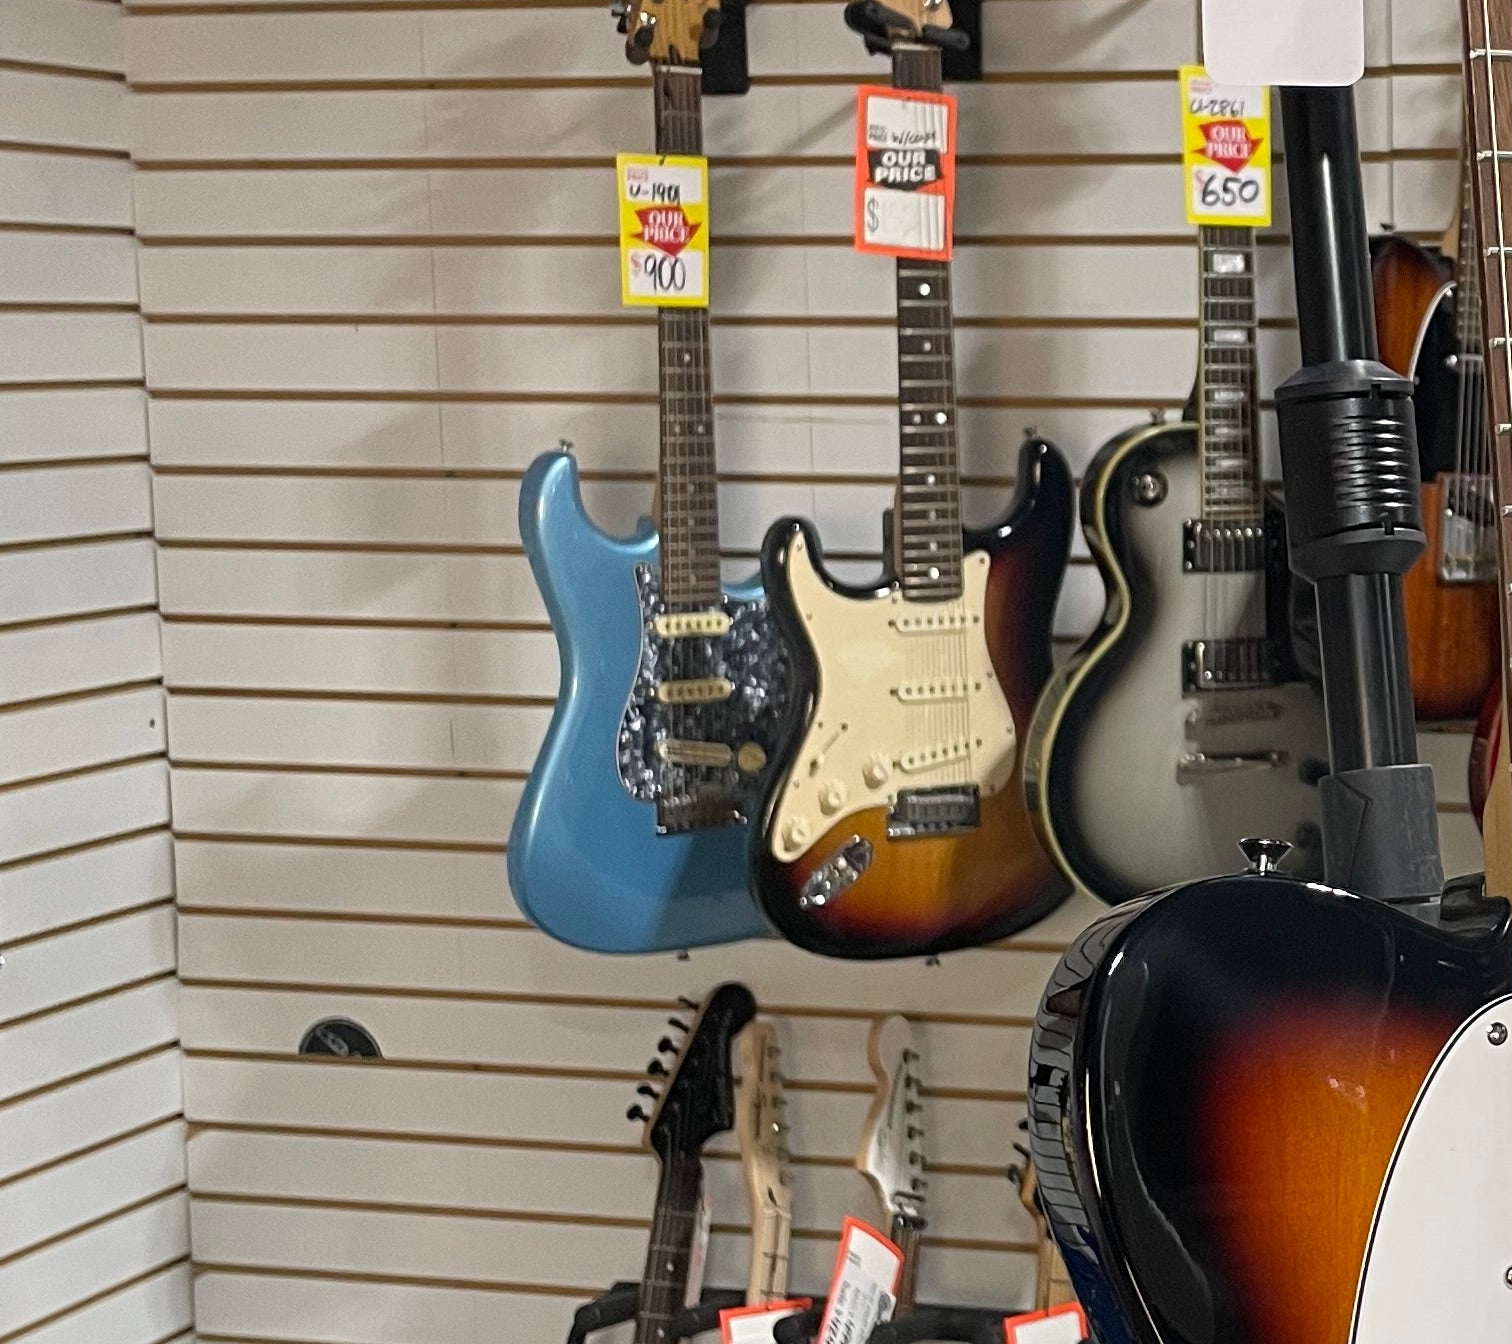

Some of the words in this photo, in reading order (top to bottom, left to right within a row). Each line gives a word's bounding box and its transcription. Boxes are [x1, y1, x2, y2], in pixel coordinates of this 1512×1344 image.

[1209, 125, 1247, 143] OUR
[881, 150, 926, 167] OUR
[1206, 141, 1250, 159] PRICE
[874, 165, 937, 184] PRICE
[648, 209, 684, 226] OUR
[644, 224, 688, 244] PRICE
